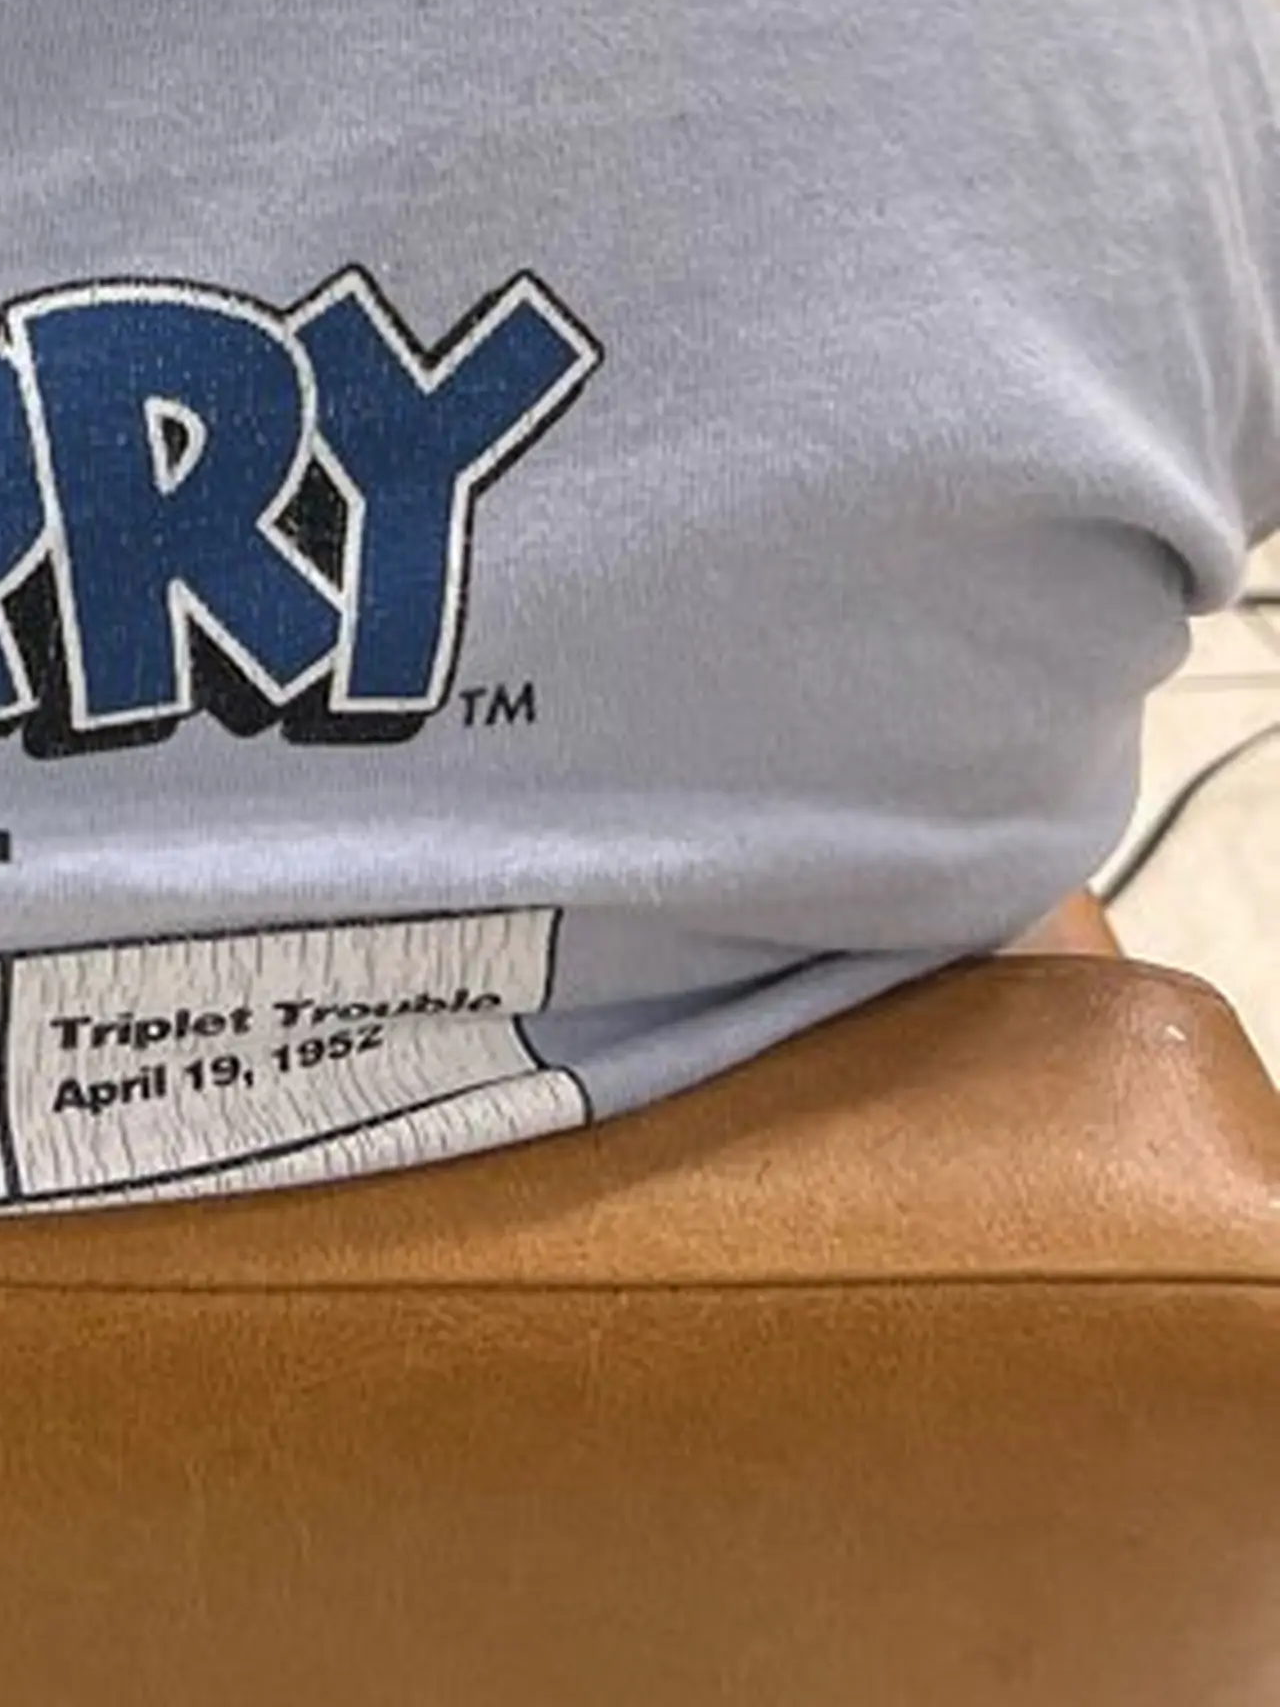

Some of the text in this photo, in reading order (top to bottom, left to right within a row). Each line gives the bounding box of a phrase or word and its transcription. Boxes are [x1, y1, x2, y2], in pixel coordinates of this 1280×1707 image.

[458, 680, 536, 727] TM
[49, 988, 503, 1051] Triplet Trouble
[51, 1022, 385, 1115] April 19, 1952
